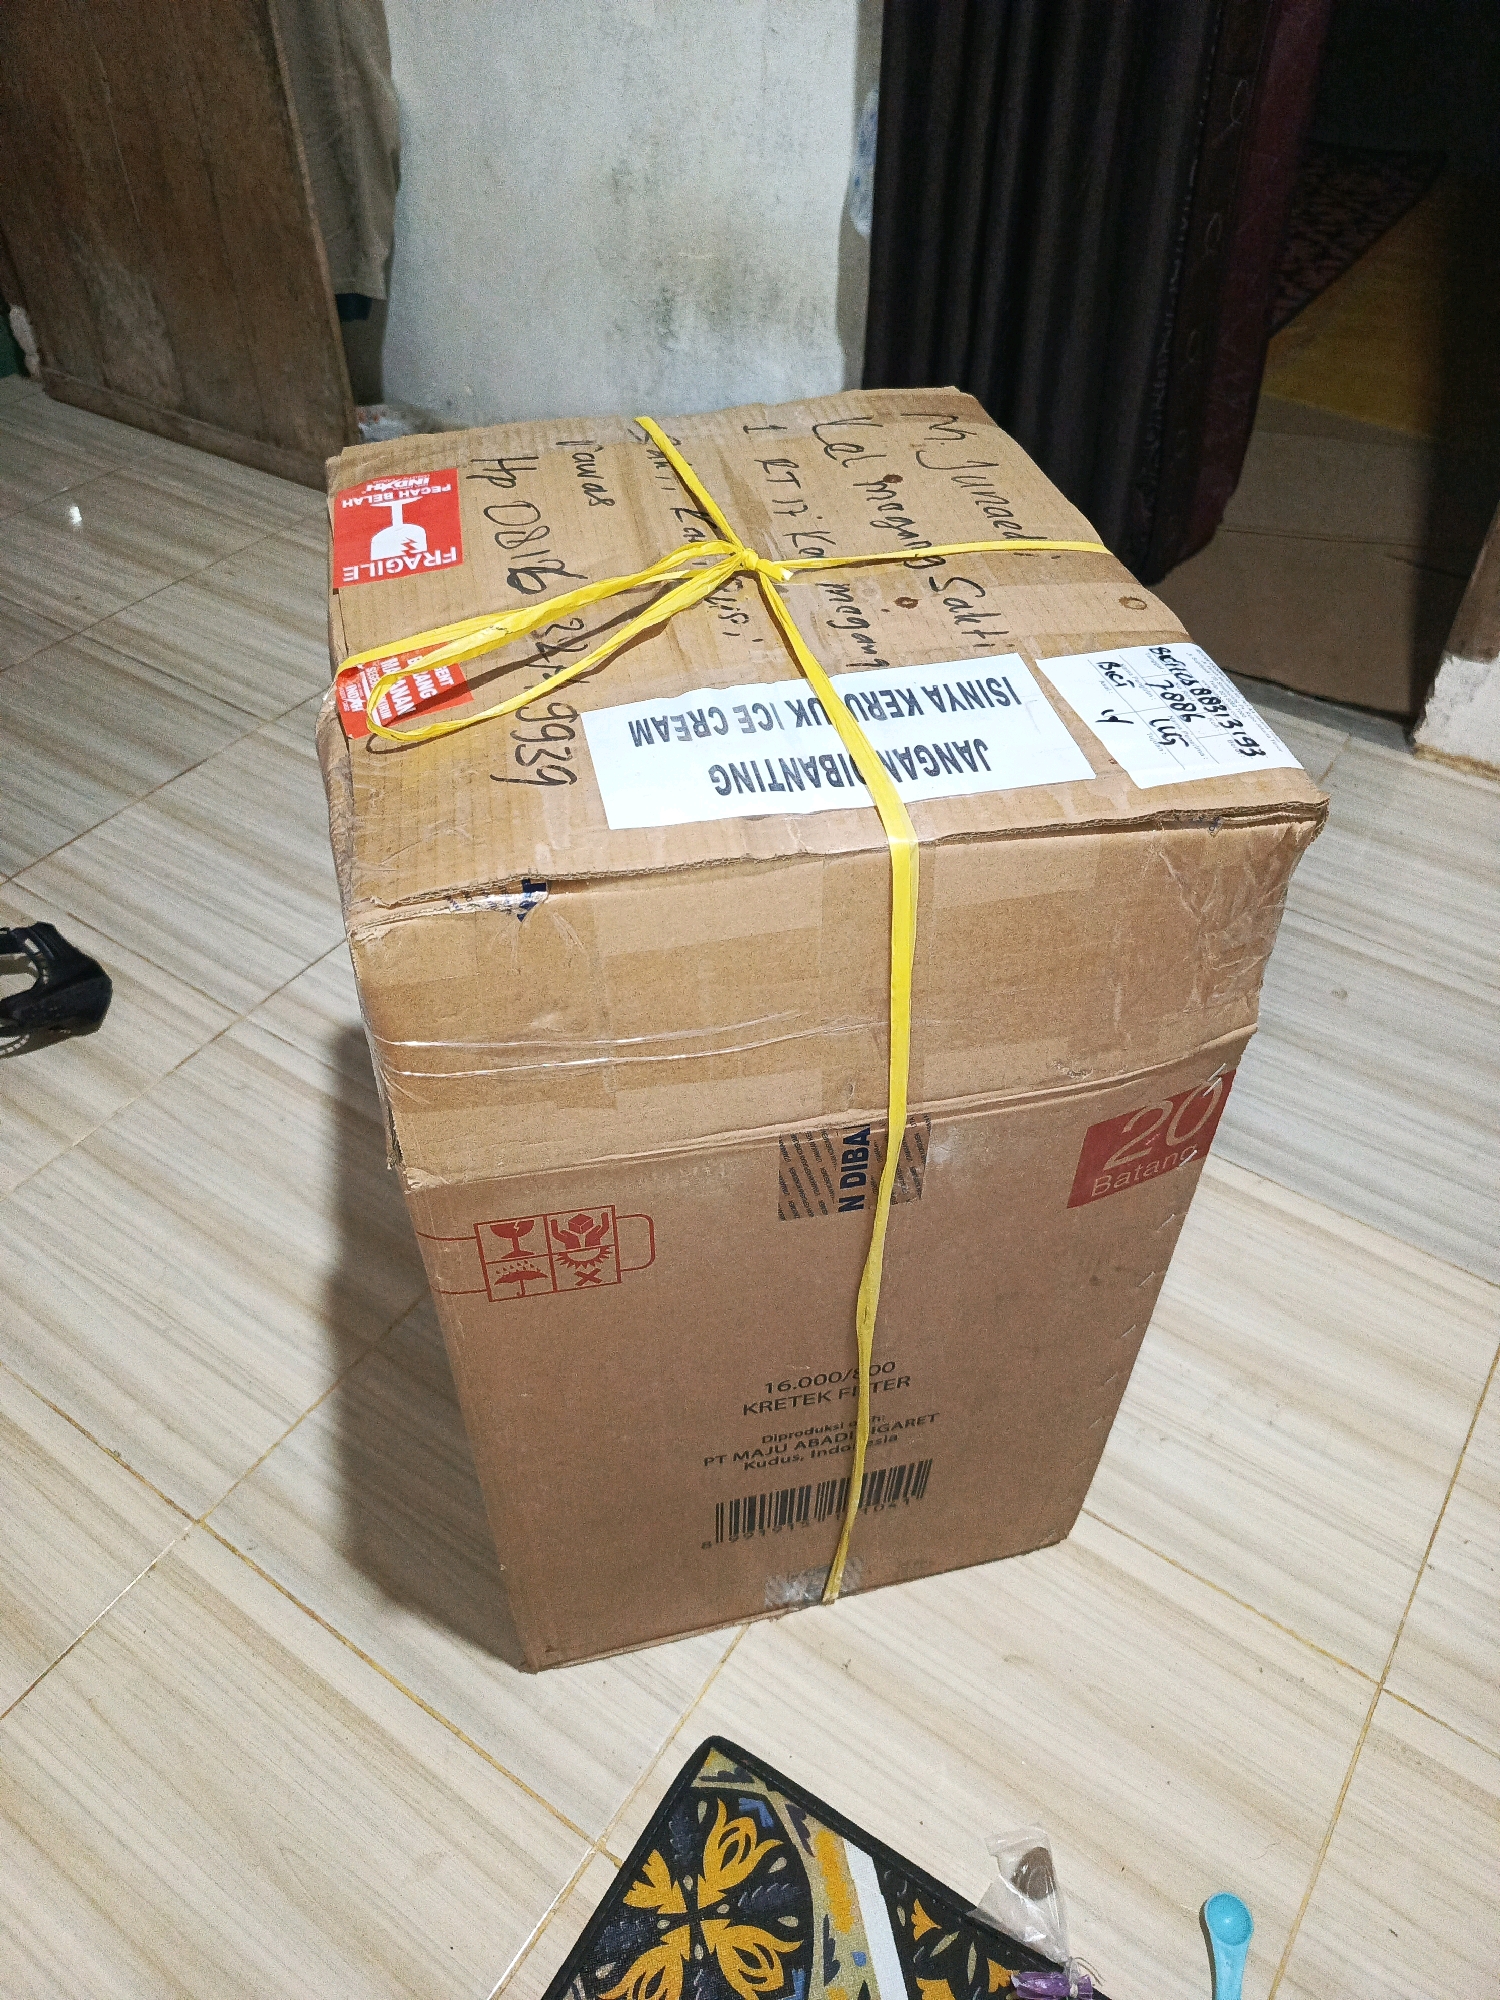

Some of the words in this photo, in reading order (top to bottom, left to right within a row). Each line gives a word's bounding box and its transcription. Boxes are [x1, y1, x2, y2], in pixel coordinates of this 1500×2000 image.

[341, 491, 394, 509] BELAH
[399, 483, 452, 499] PECAH
[342, 546, 457, 582] FRAGILE
[784, 684, 923, 729] KERUUK
[923, 675, 1022, 713] ISINYA
[627, 708, 729, 748] CREAM
[739, 701, 784, 735] ICE
[709, 752, 869, 797] DIBANTING
[877, 738, 992, 783] JANGAN
[1103, 1076, 1223, 1171] 20
[838, 1123, 871, 1190] DIBA
[743, 1390, 832, 1416] KRETEK
[838, 1375, 912, 1400] FITER
[765, 1361, 896, 1394] 16.000/800
[703, 1453, 728, 1467] PT
[732, 1443, 790, 1463] MAJU
[793, 1431, 854, 1451] ABADI
[866, 1412, 940, 1436] IGARET
[743, 1453, 805, 1471] Kudus,
[810, 1432, 898, 1459] Indoesia
[762, 1421, 844, 1444] Diproduksi
